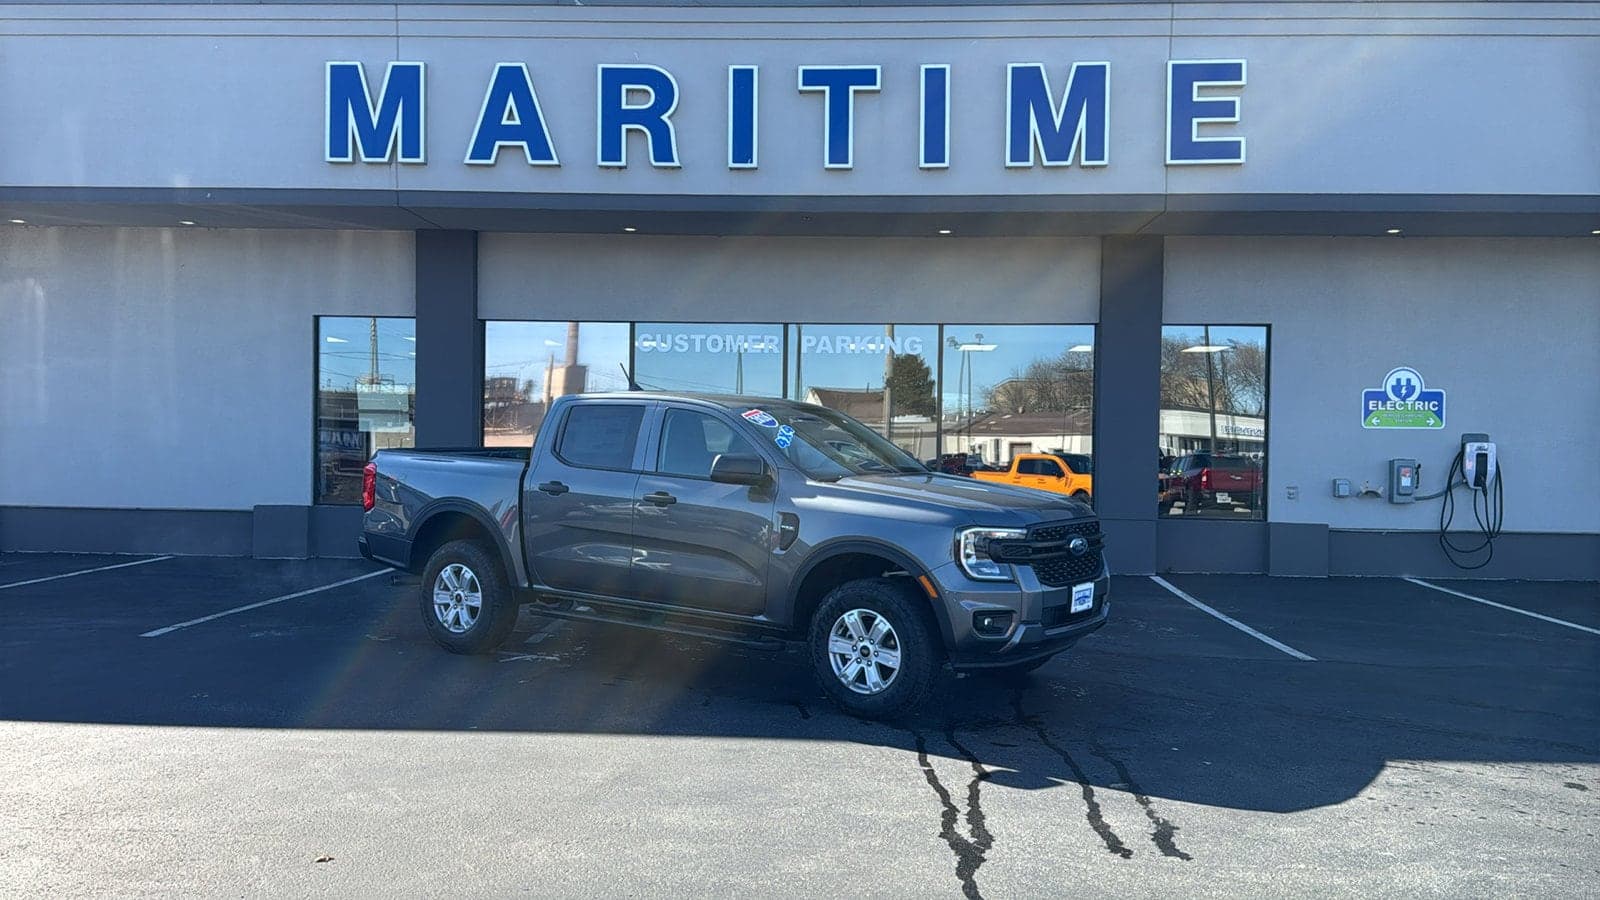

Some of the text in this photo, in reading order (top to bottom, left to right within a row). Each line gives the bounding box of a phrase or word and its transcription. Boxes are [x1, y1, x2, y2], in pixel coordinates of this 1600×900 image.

[325, 59, 1247, 169] MARITIME
[638, 333, 923, 354] CUSTOMER PARKING
[1368, 400, 1439, 411] ELECTRIC
